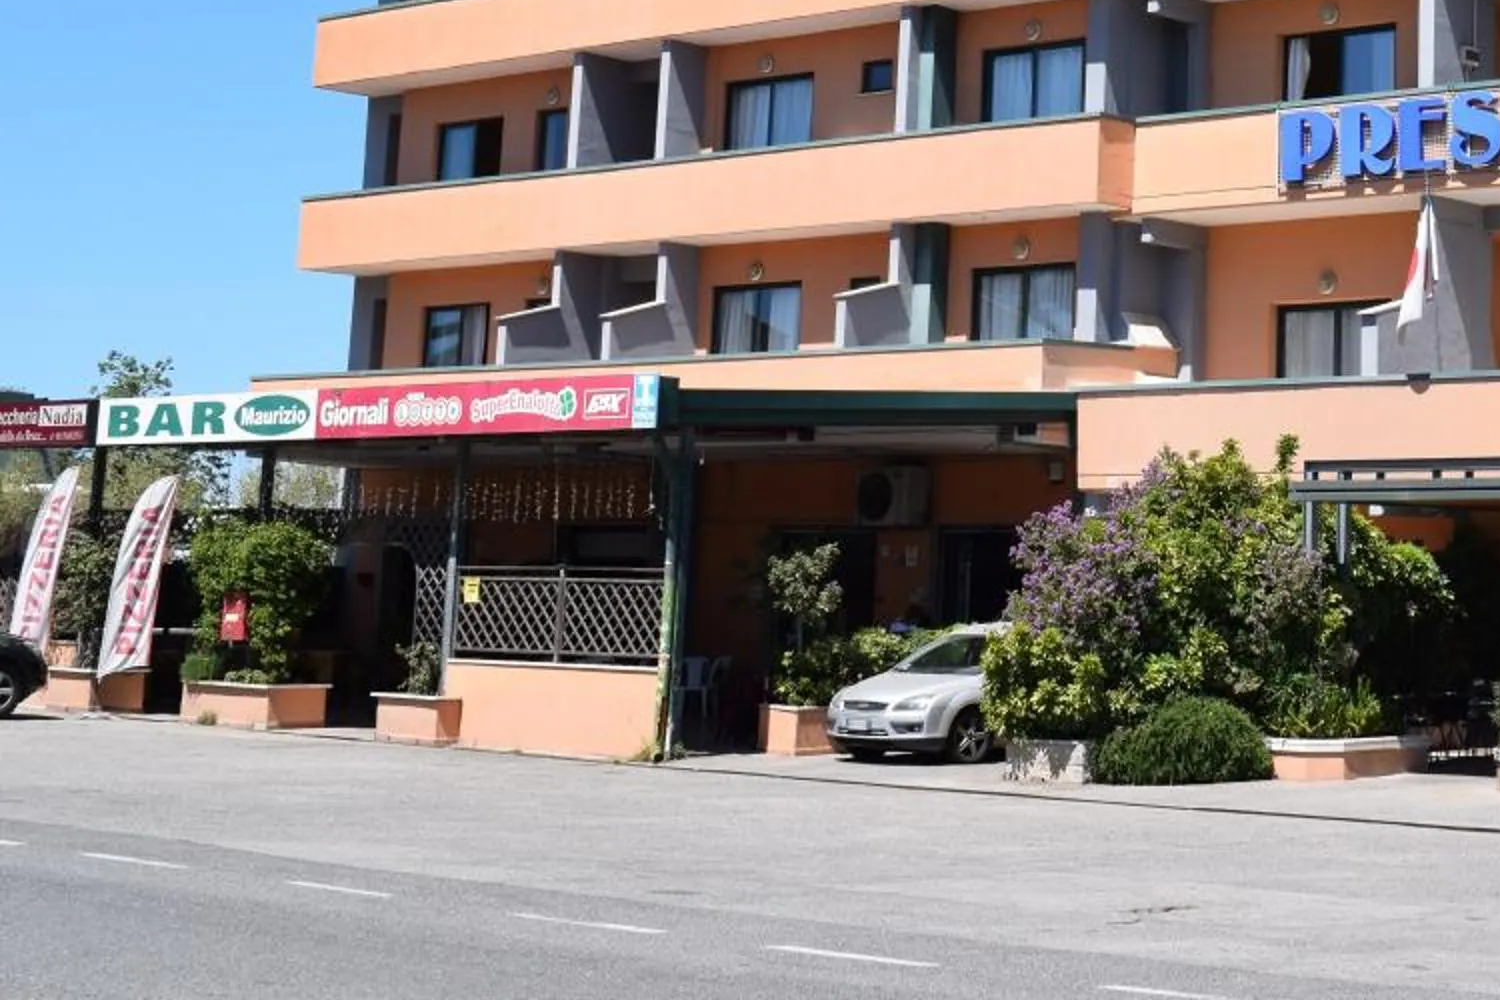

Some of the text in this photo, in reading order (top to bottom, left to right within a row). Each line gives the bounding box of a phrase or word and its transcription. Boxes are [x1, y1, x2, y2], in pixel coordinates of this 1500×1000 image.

[41, 407, 83, 424] Nadia
[108, 401, 307, 438] BAR Maurizio
[320, 398, 389, 427] Giornali
